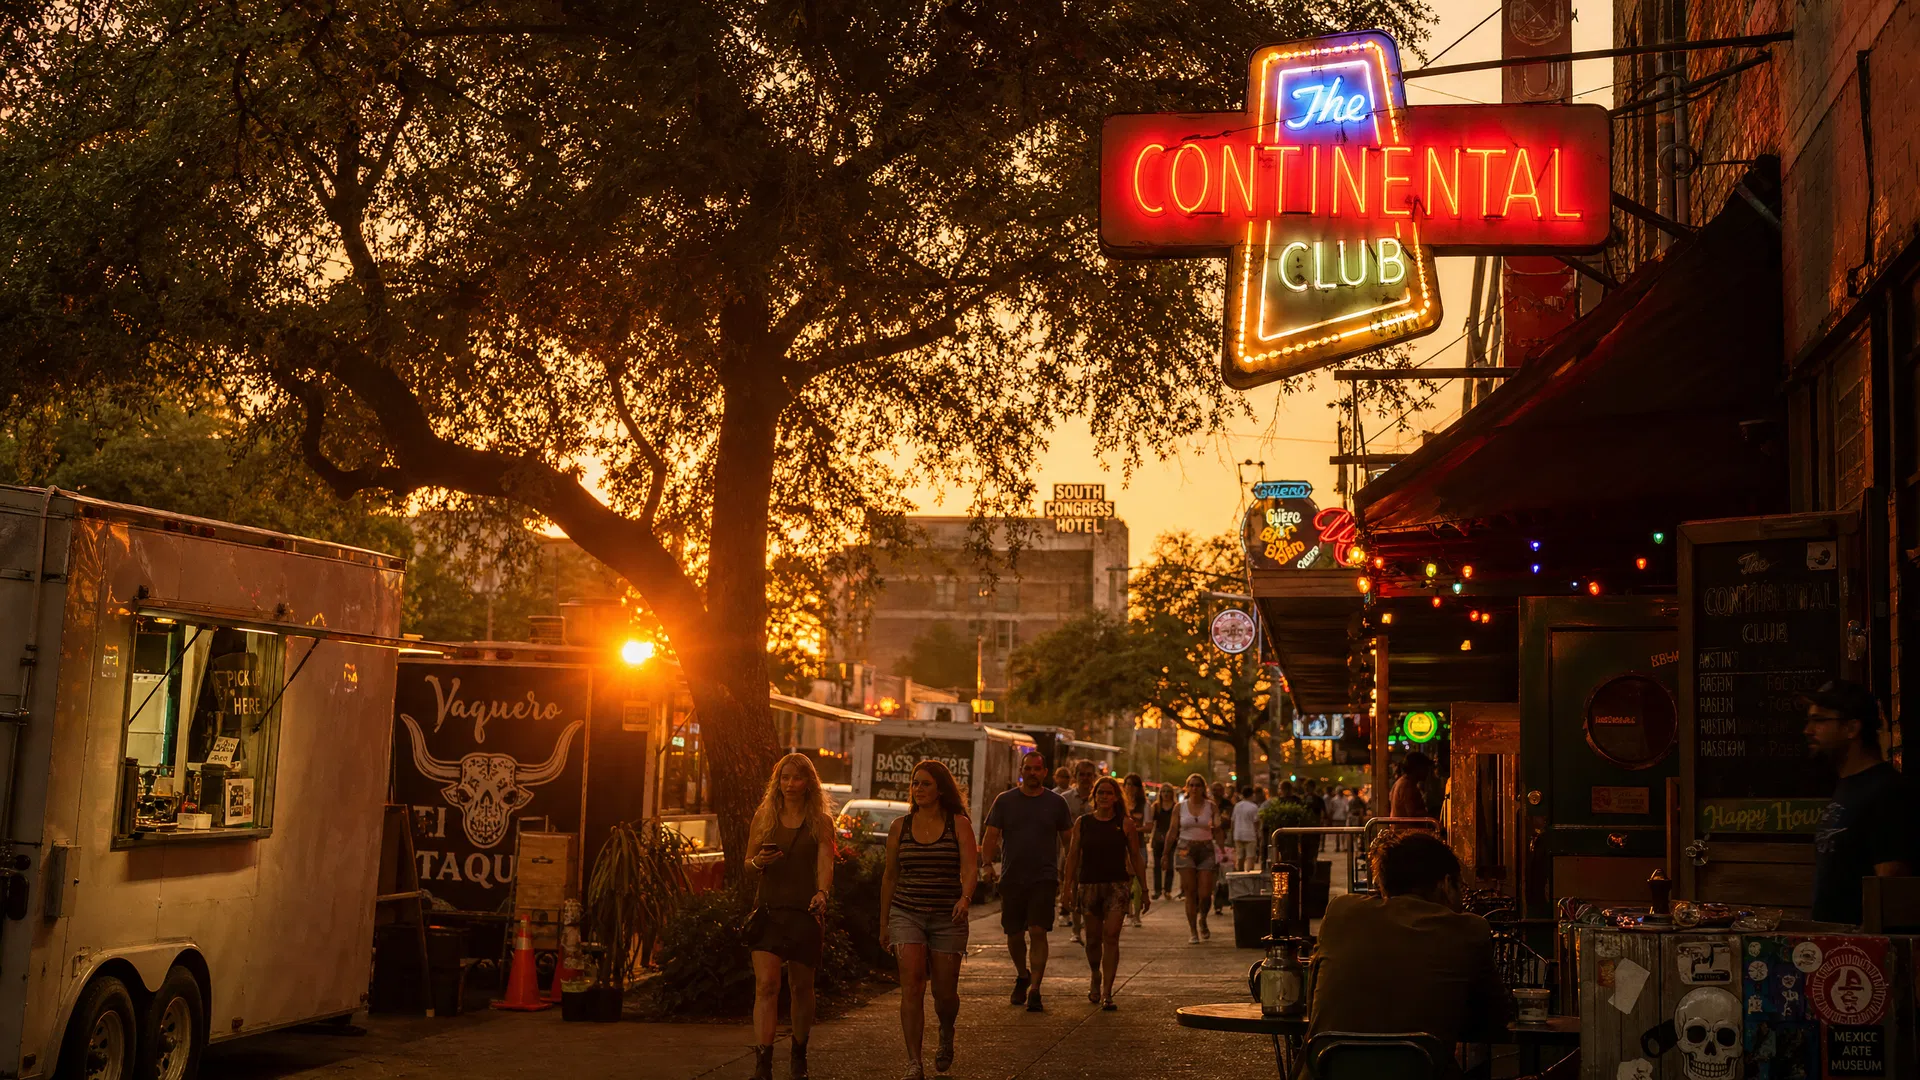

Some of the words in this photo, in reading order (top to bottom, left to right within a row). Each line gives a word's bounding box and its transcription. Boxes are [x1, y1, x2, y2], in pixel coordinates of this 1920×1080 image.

[1284, 76, 1368, 129] The
[1132, 142, 1583, 218] CONTINENTAL
[1278, 236, 1407, 292] CLUB
[1055, 485, 1103, 500] SOUTH
[1045, 501, 1113, 517] CONGRESS
[1055, 518, 1103, 533] HOTEL
[1741, 622, 1789, 644] CLUB
[226, 669, 250, 687] PICK
[233, 697, 261, 716] HERE
[424, 674, 563, 744] Vaquero
[1703, 804, 1769, 832] Happy
[1841, 1045, 1872, 1057] ARTE
[1831, 1059, 1882, 1072] MUSEUM
